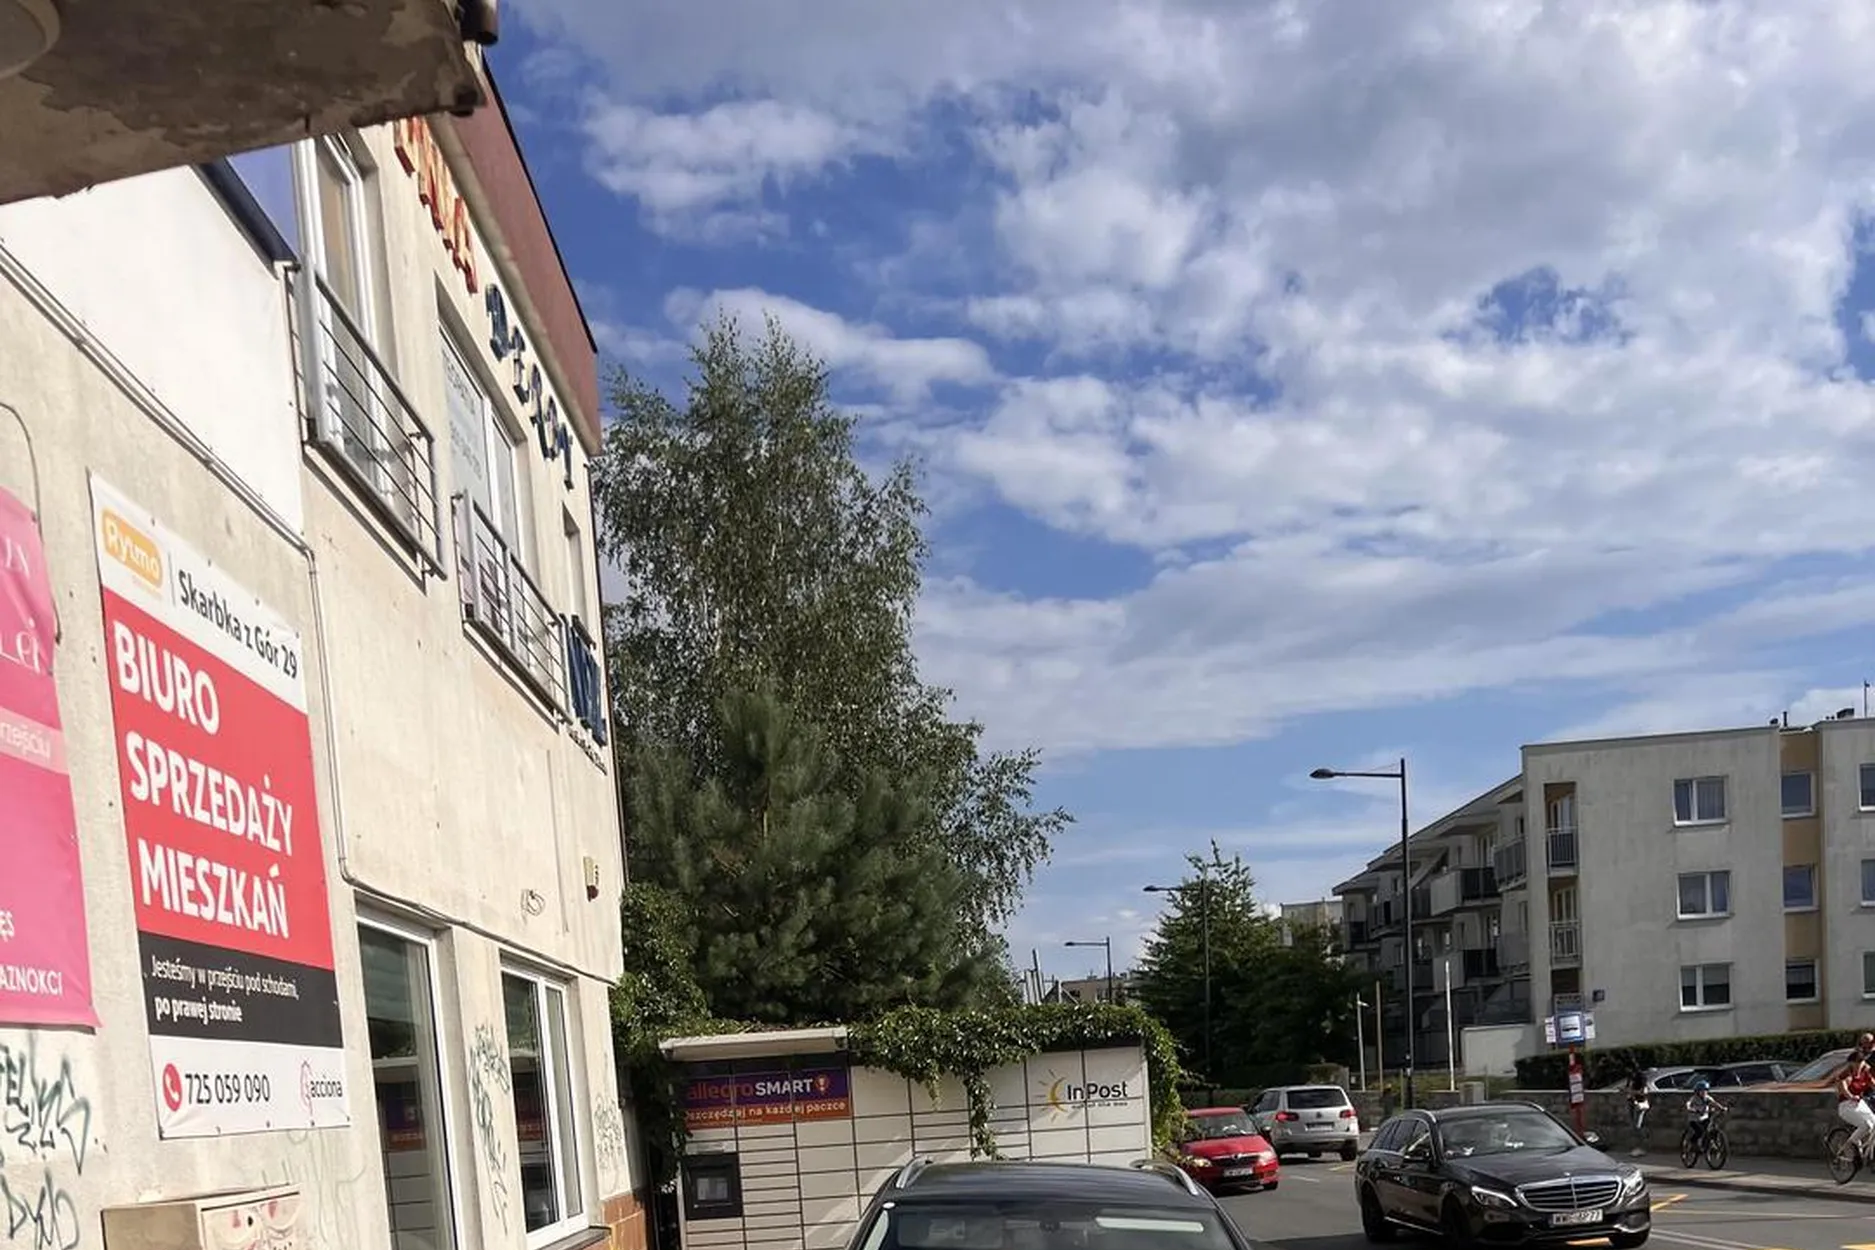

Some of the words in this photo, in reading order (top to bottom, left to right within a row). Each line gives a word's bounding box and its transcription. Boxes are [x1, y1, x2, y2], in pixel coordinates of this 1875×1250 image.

[178, 569, 242, 643] Skarbka
[244, 624, 253, 650] z
[254, 626, 279, 668] Gór
[281, 644, 298, 679] 29
[113, 620, 220, 736] BIURO
[125, 731, 292, 856] SPRZEDAŻY
[137, 838, 290, 939] MIESZKAŃ
[152, 954, 196, 989] Jesteśmy
[197, 968, 206, 985] w
[207, 966, 244, 994] przejściu
[245, 972, 262, 996] pod
[154, 996, 171, 1021] po
[171, 996, 209, 1025] prawej
[208, 1000, 243, 1022] stronie
[185, 1073, 212, 1104] 725
[215, 1073, 241, 1103] 059
[244, 1074, 271, 1103] 090
[310, 1074, 343, 1098] acciona
[687, 1082, 754, 1103] allegro
[1067, 1081, 1128, 1100] InPost
[749, 1107, 764, 1117] na
[765, 1103, 805, 1115] każdej
[806, 1102, 846, 1114] paczce
